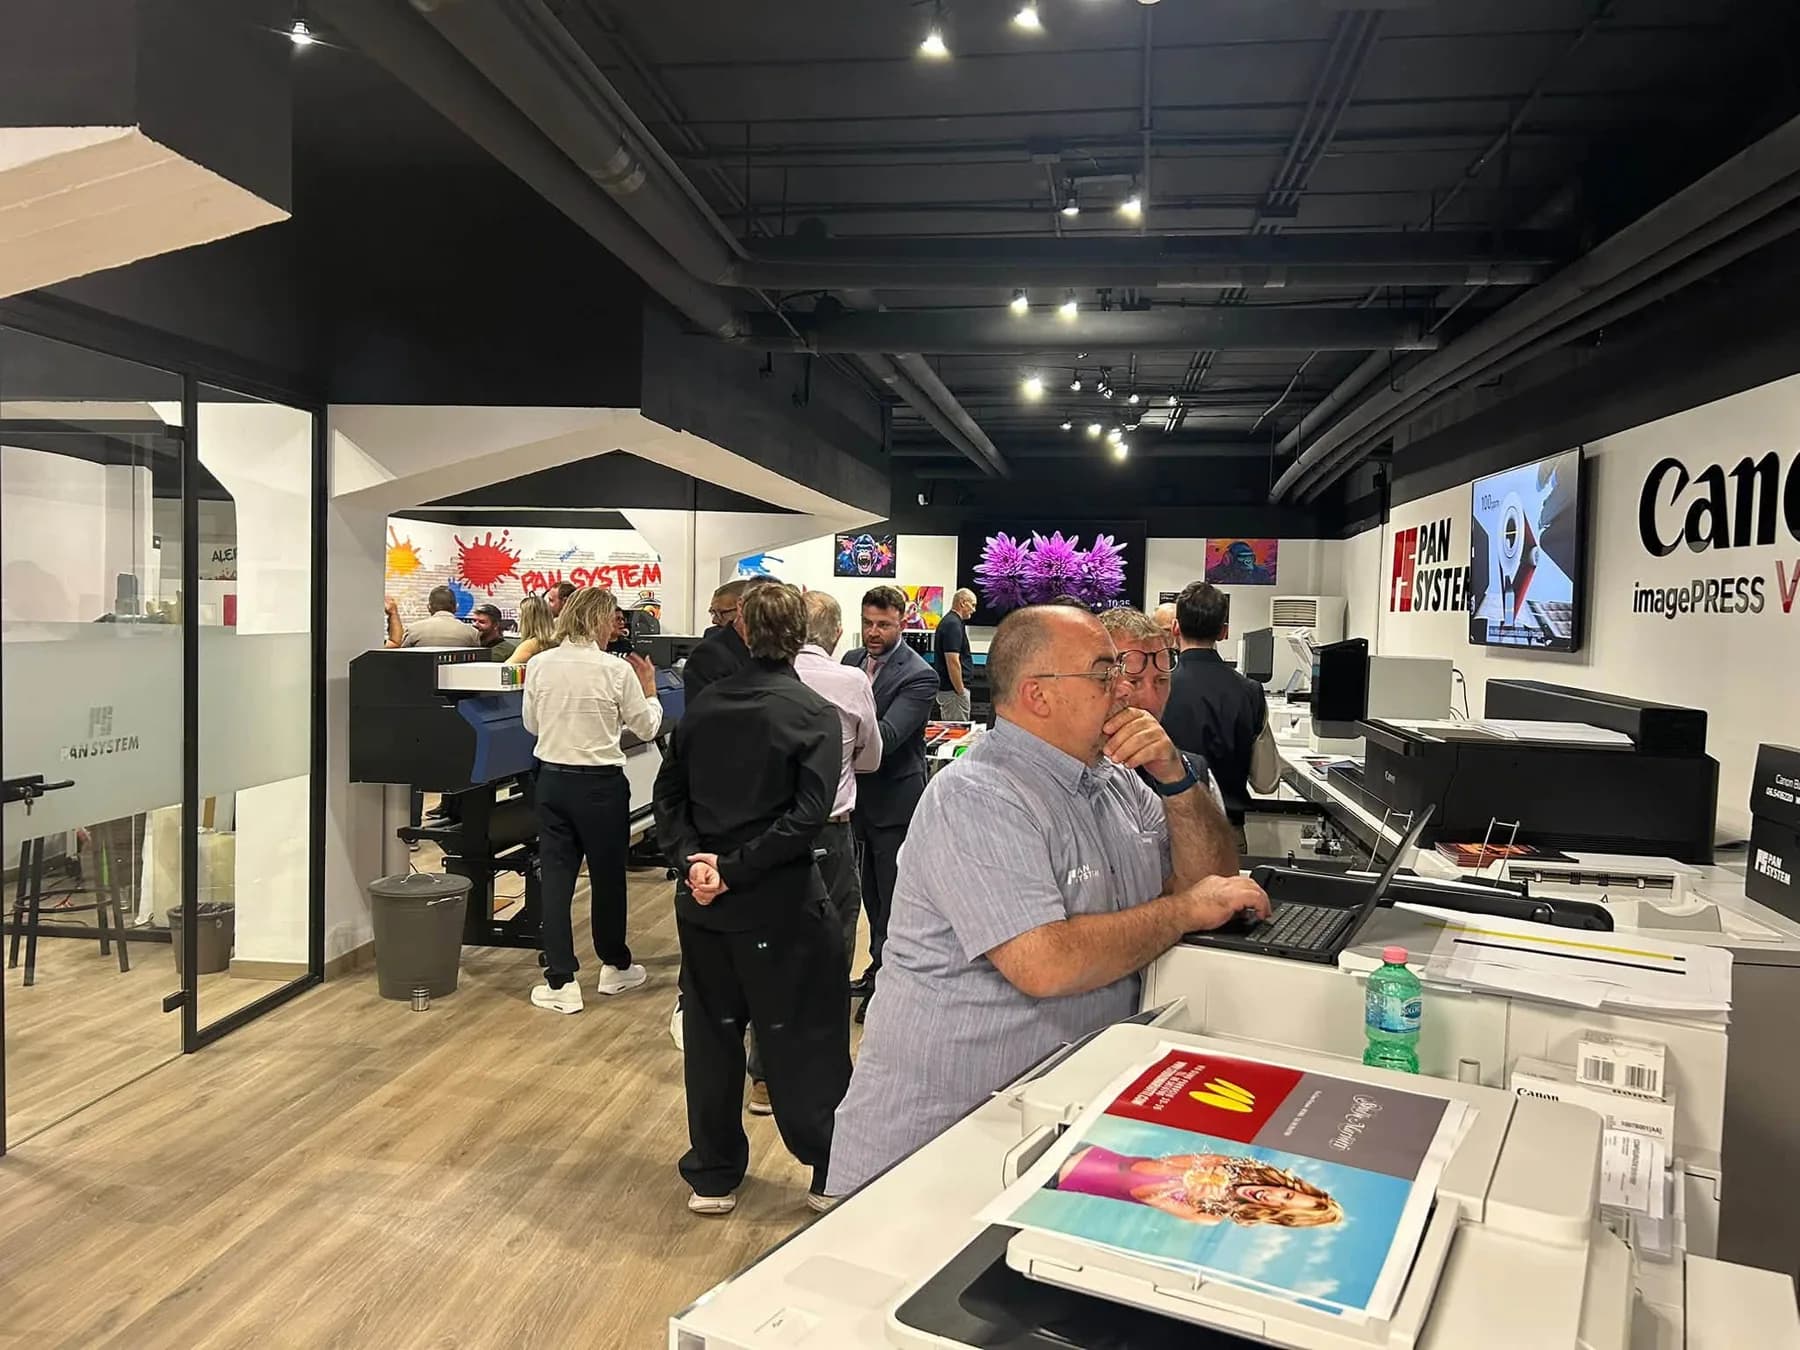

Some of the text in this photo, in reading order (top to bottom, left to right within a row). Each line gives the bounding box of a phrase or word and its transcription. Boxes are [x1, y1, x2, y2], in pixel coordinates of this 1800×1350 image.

[1418, 518, 1452, 566] PAN
[520, 562, 661, 595] PAN SYSTEM
[1633, 576, 1765, 620] imagePRESS
[90, 735, 140, 757] SYSTEM
[1767, 853, 1782, 869] PAN
[1766, 864, 1791, 885] SYSTEM
[1516, 1087, 1559, 1102] Canon
